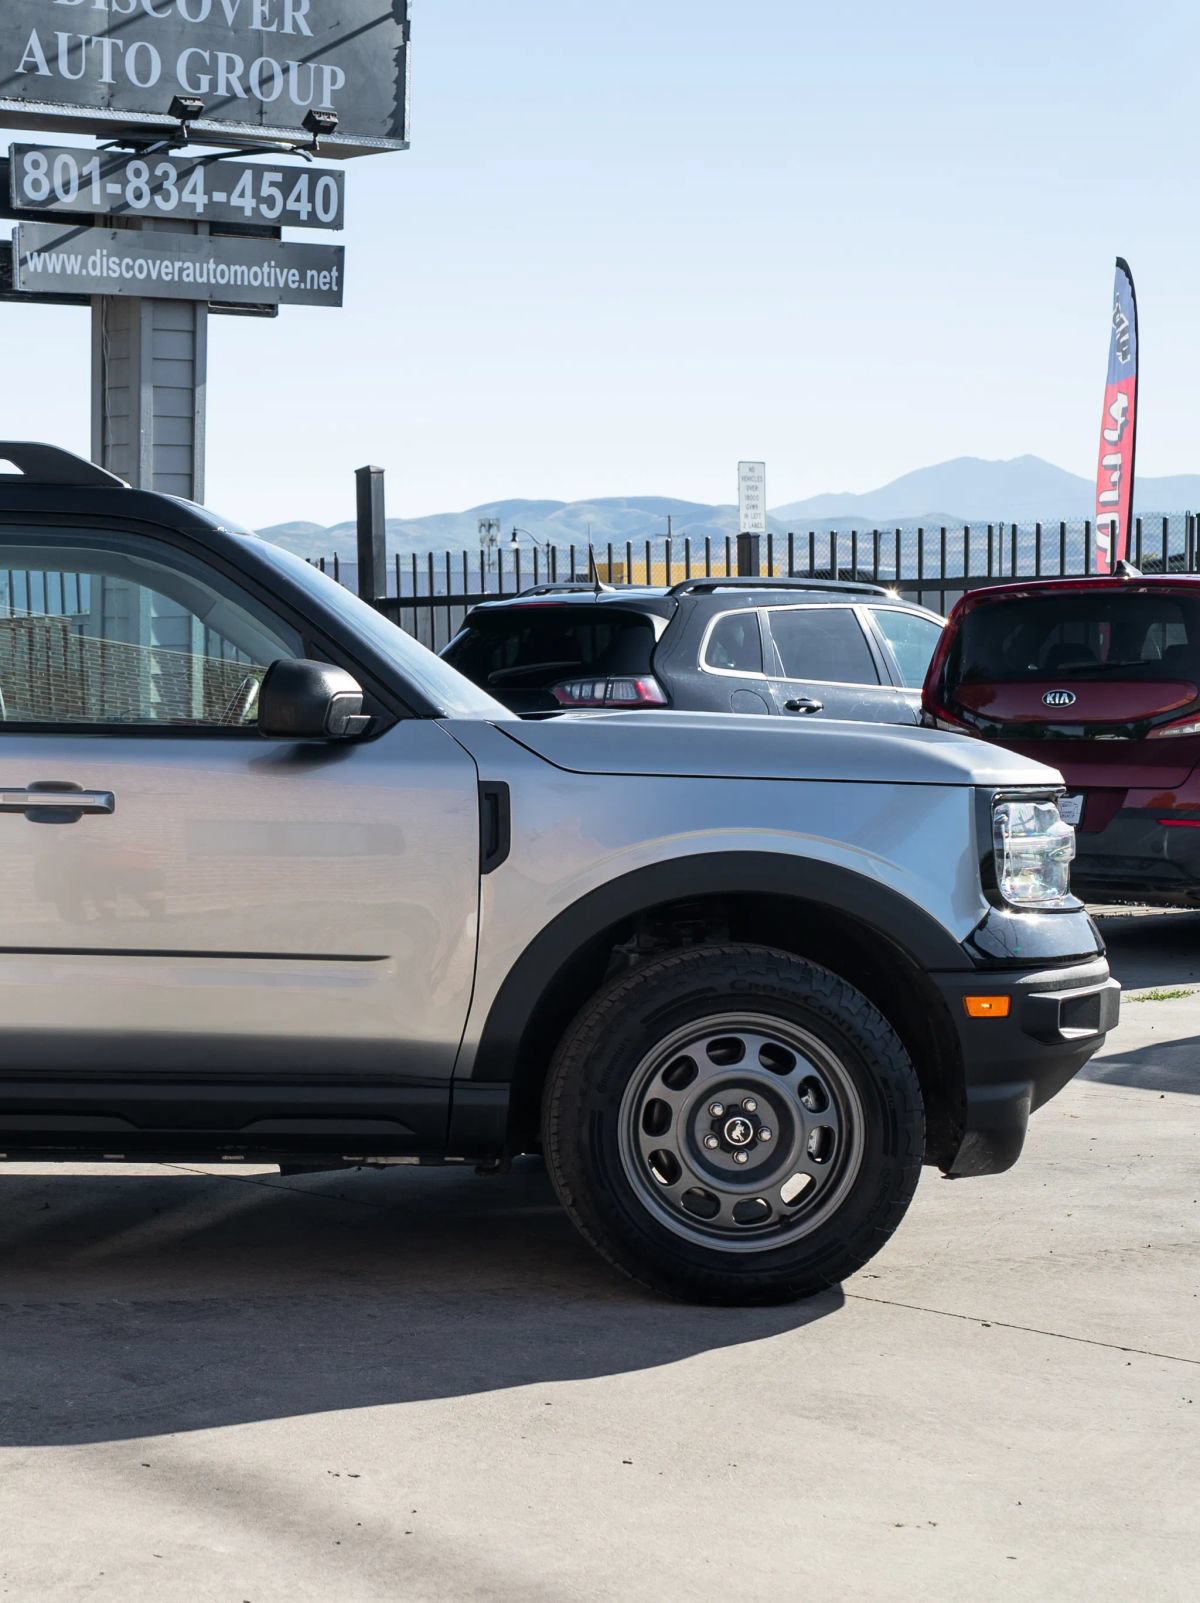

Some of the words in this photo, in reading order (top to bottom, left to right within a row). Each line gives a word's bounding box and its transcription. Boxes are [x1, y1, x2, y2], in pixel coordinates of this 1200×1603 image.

[52, 0, 314, 37] OVER
[15, 28, 162, 89] AUTO
[175, 47, 346, 109] GROUP
[22, 152, 338, 222] 801-834-4540
[26, 250, 338, 291] www.discoverautomotive.net
[1046, 692, 1070, 704] KIA
